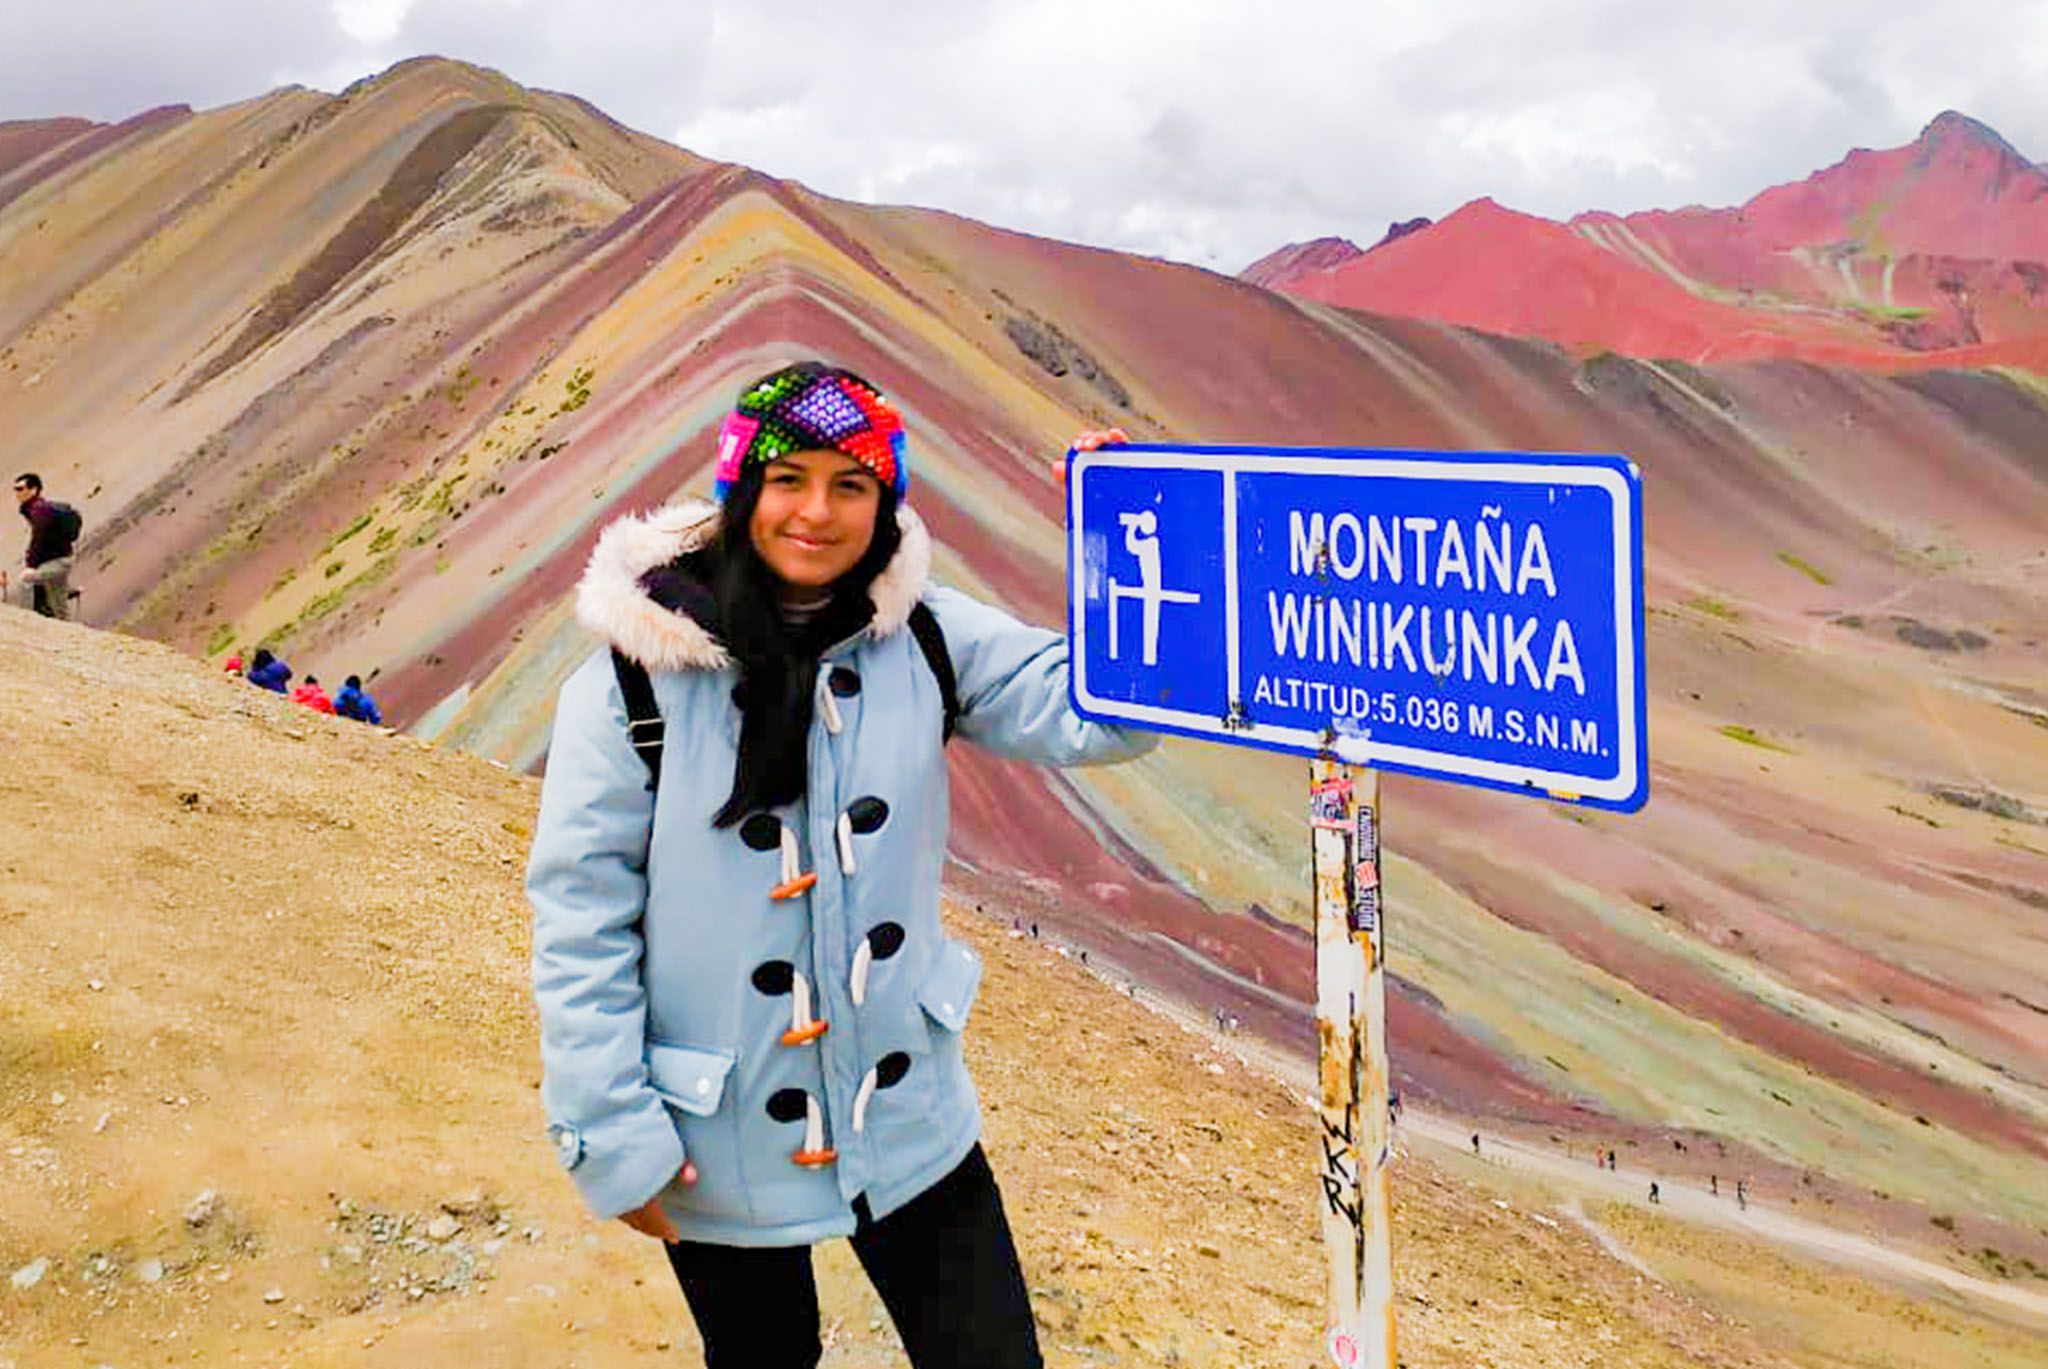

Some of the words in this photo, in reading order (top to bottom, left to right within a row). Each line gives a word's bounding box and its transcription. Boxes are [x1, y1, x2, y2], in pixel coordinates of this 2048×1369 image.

[1289, 505, 1558, 598] MONTAÑA
[1268, 590, 1586, 696] WINIKUNKA
[1468, 703, 1610, 758] M.S.N.M.
